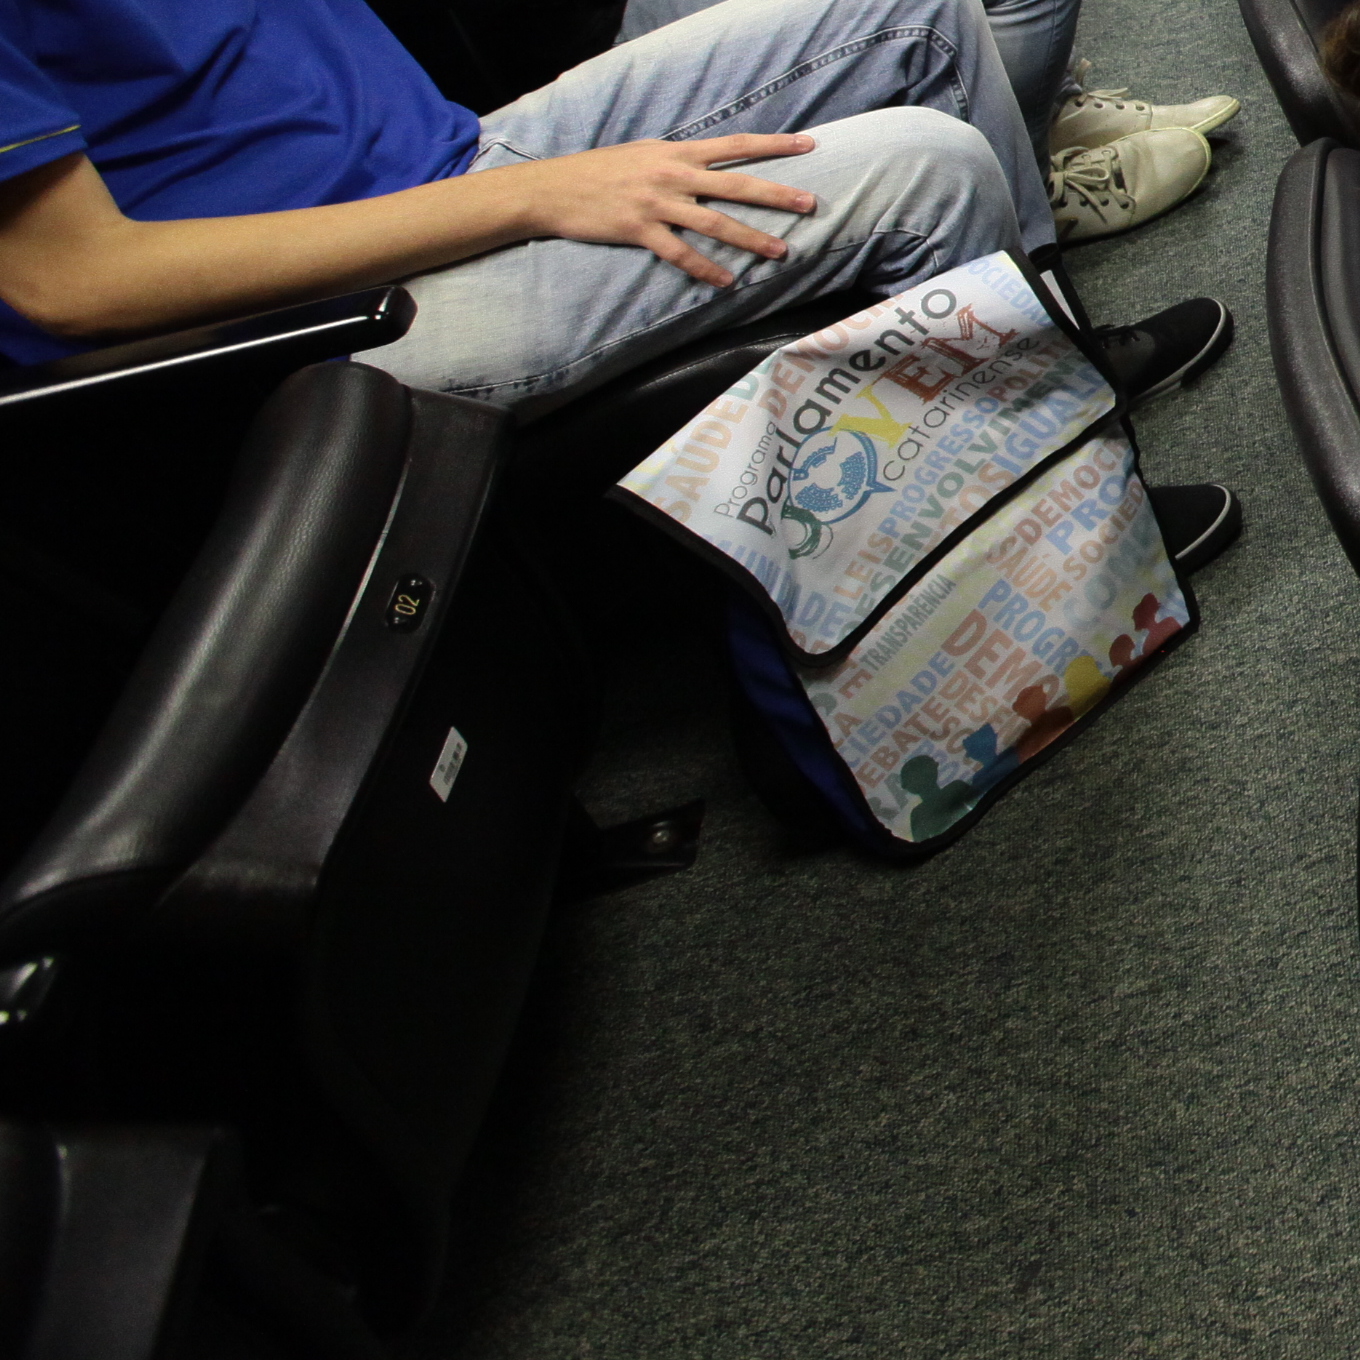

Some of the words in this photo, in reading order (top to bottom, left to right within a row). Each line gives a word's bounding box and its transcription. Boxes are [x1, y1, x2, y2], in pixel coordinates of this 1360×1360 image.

[713, 421, 776, 519] Programa
[736, 288, 957, 536] Parlamento
[781, 303, 1020, 560] JOVEM
[882, 337, 1040, 481] catarinense
[833, 533, 894, 600] LEIS
[877, 395, 1001, 539] PROGRESSO
[860, 573, 956, 672] TRANSPARÊNCIA
